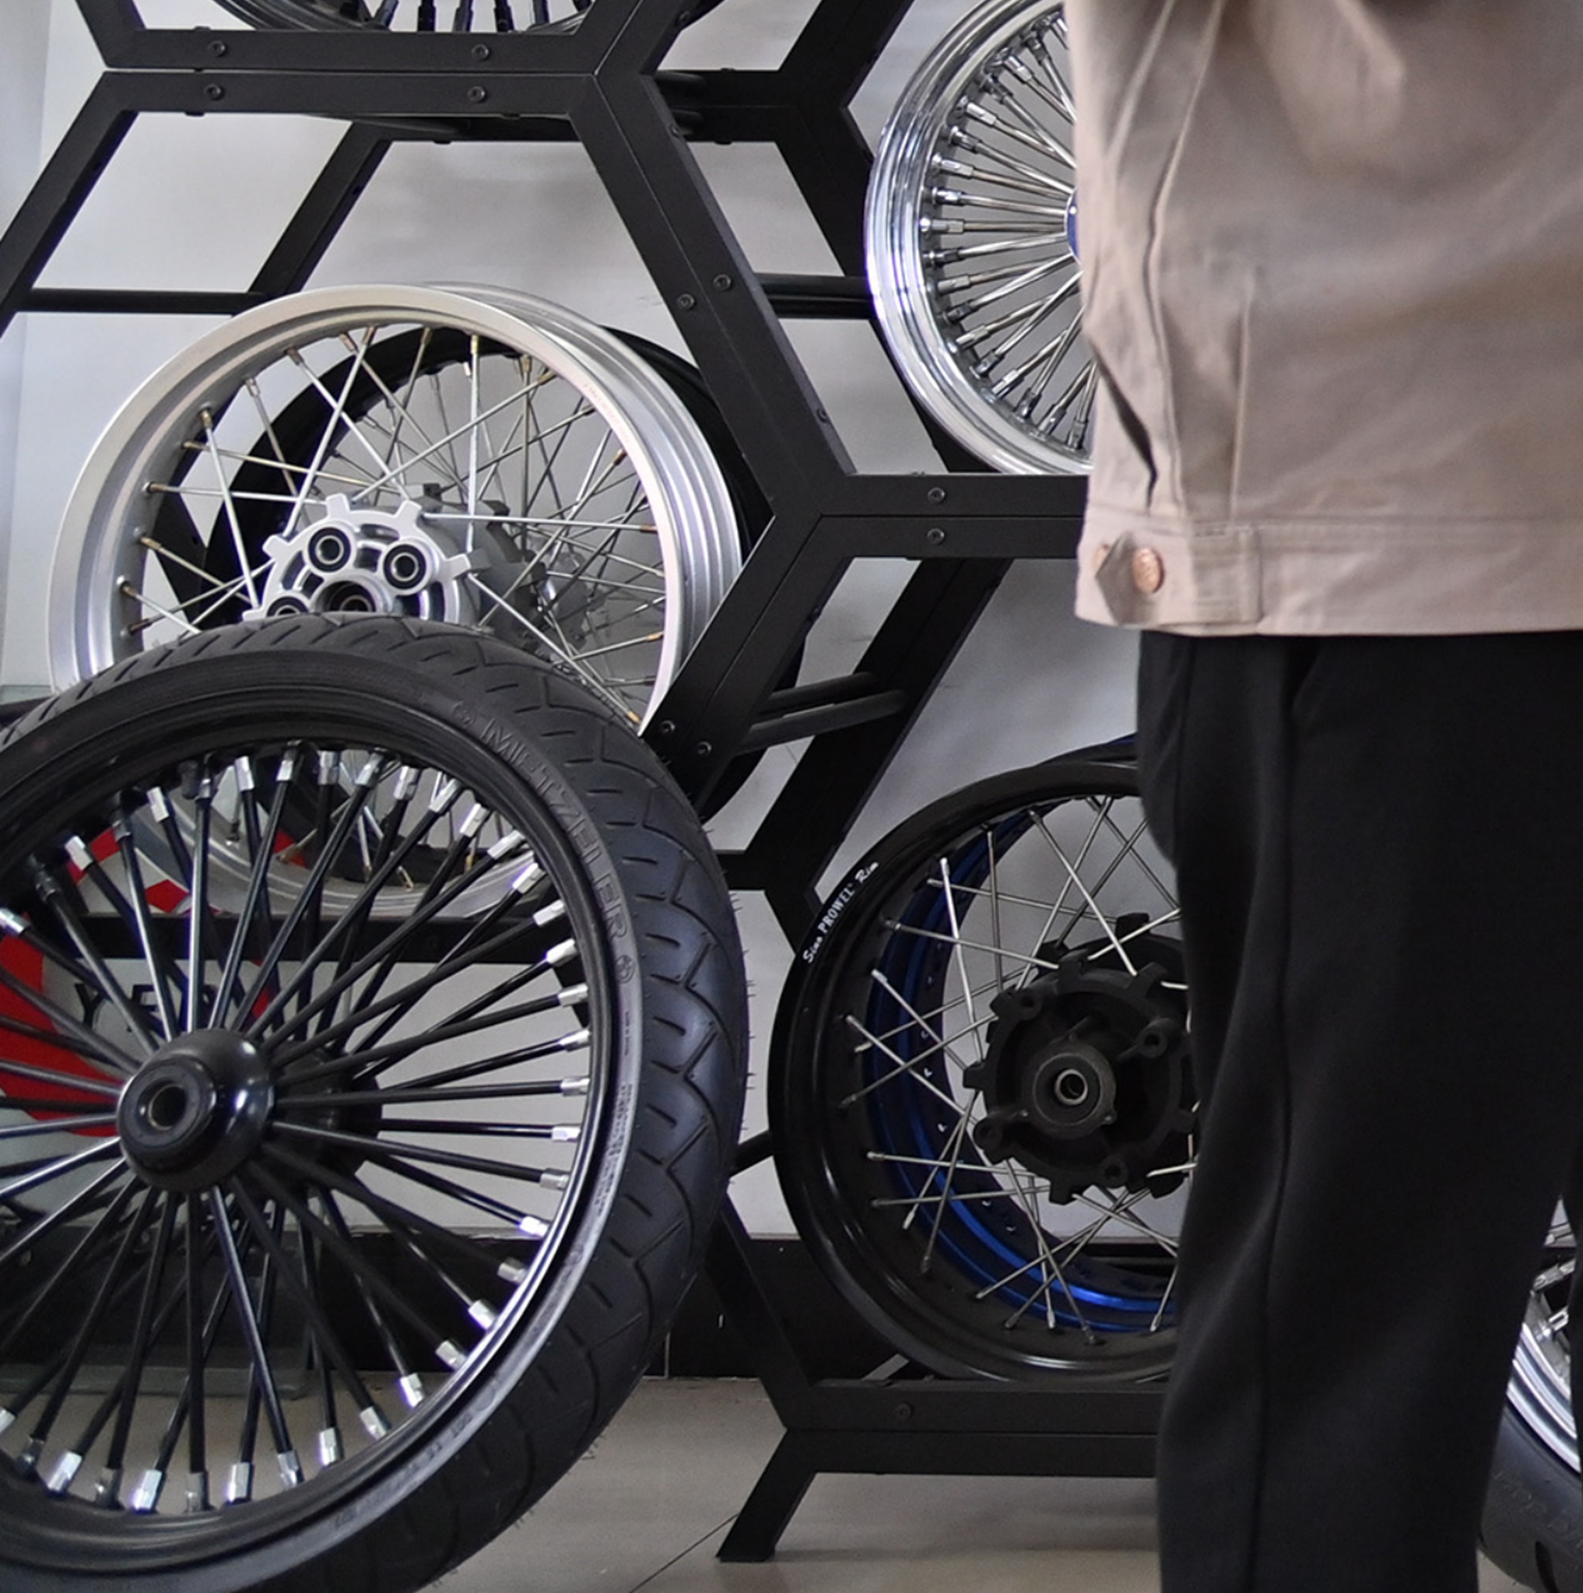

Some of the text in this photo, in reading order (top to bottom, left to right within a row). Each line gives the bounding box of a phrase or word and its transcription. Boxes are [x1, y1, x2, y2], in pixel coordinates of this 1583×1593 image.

[801, 861, 880, 964] Sino PROWEL Rim
